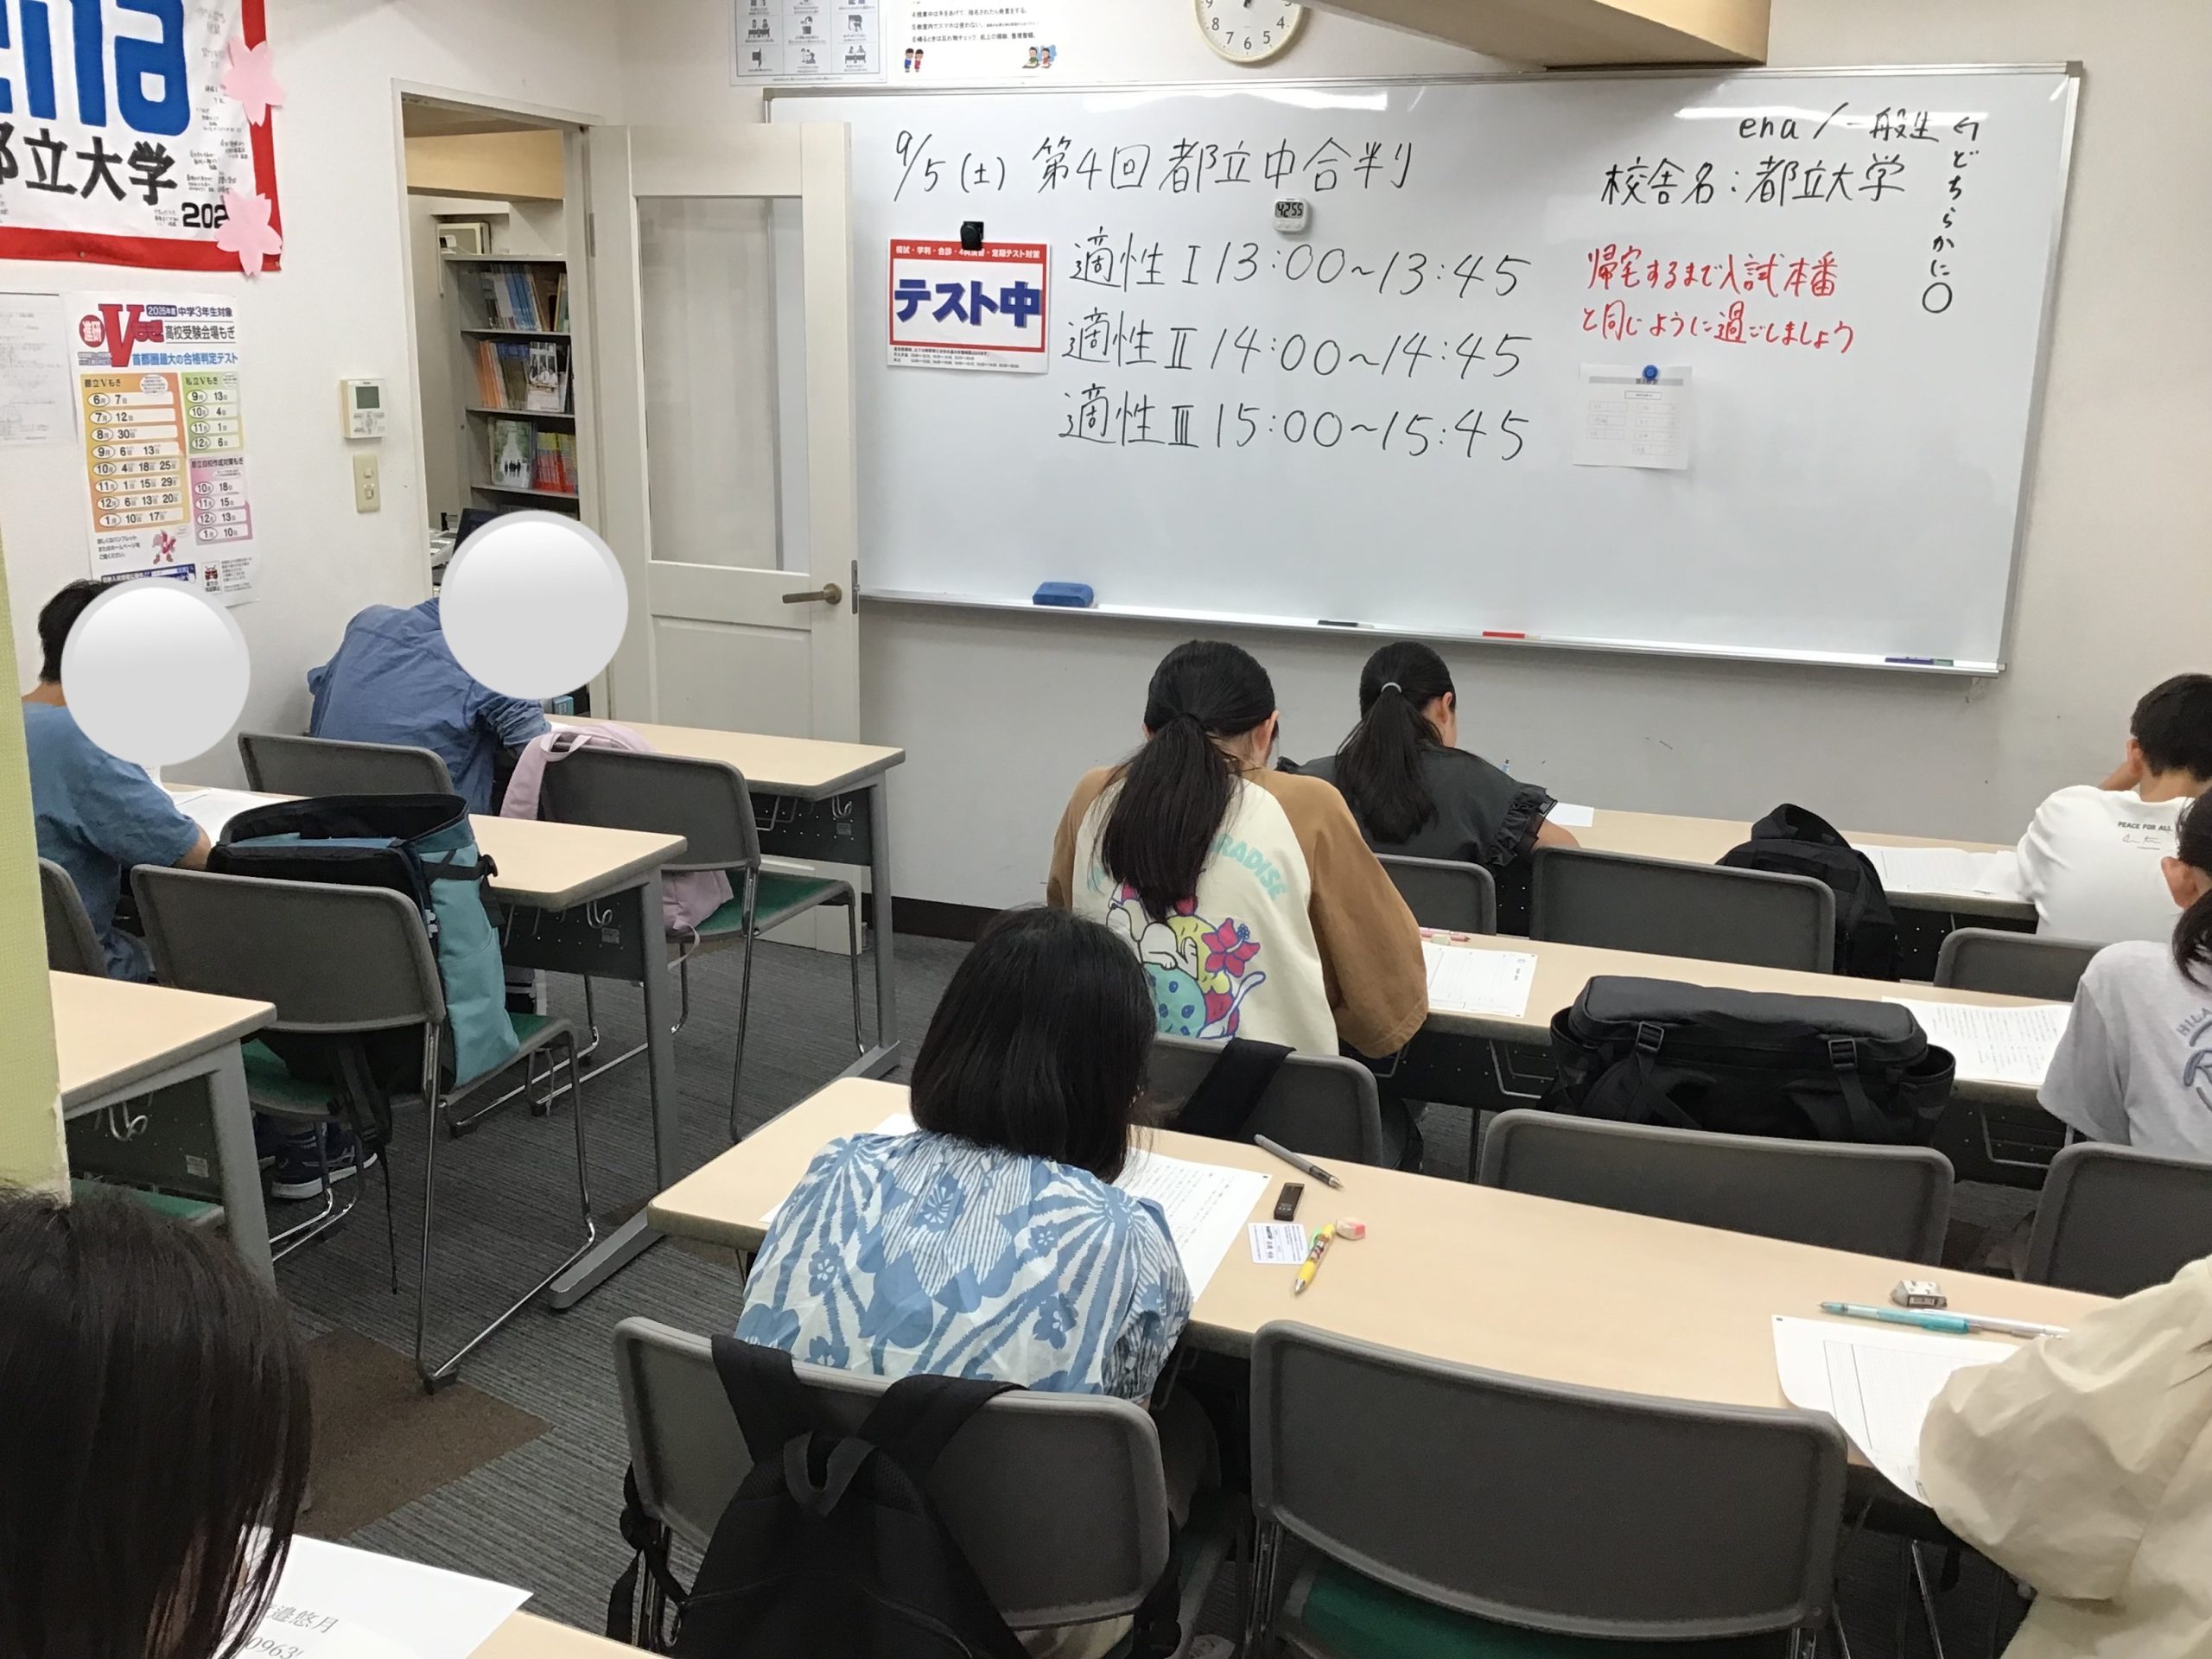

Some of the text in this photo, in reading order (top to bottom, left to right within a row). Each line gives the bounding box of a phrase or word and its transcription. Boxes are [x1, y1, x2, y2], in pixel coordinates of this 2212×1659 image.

[1211, 17, 1220, 31] 8
[1276, 16, 1285, 29] 4
[1226, 31, 1235, 44] 7
[1243, 36, 1252, 50] 6
[1263, 31, 1271, 44] 5
[0, 0, 190, 137] na
[181, 202, 229, 228] 202
[1587, 245, 1839, 297] 帰宅するまで入試本番
[893, 278, 1042, 327] テスト中
[165, 325, 235, 340] 高校受験会場もぎ
[1582, 300, 1856, 353] と同じように過ごしましょう
[132, 352, 238, 365] 首都圏最大の合格判定テスト
[2117, 821, 2140, 830] PEACE
[1211, 833, 1288, 901] RADISE
[2176, 1007, 2212, 1037] HILA
